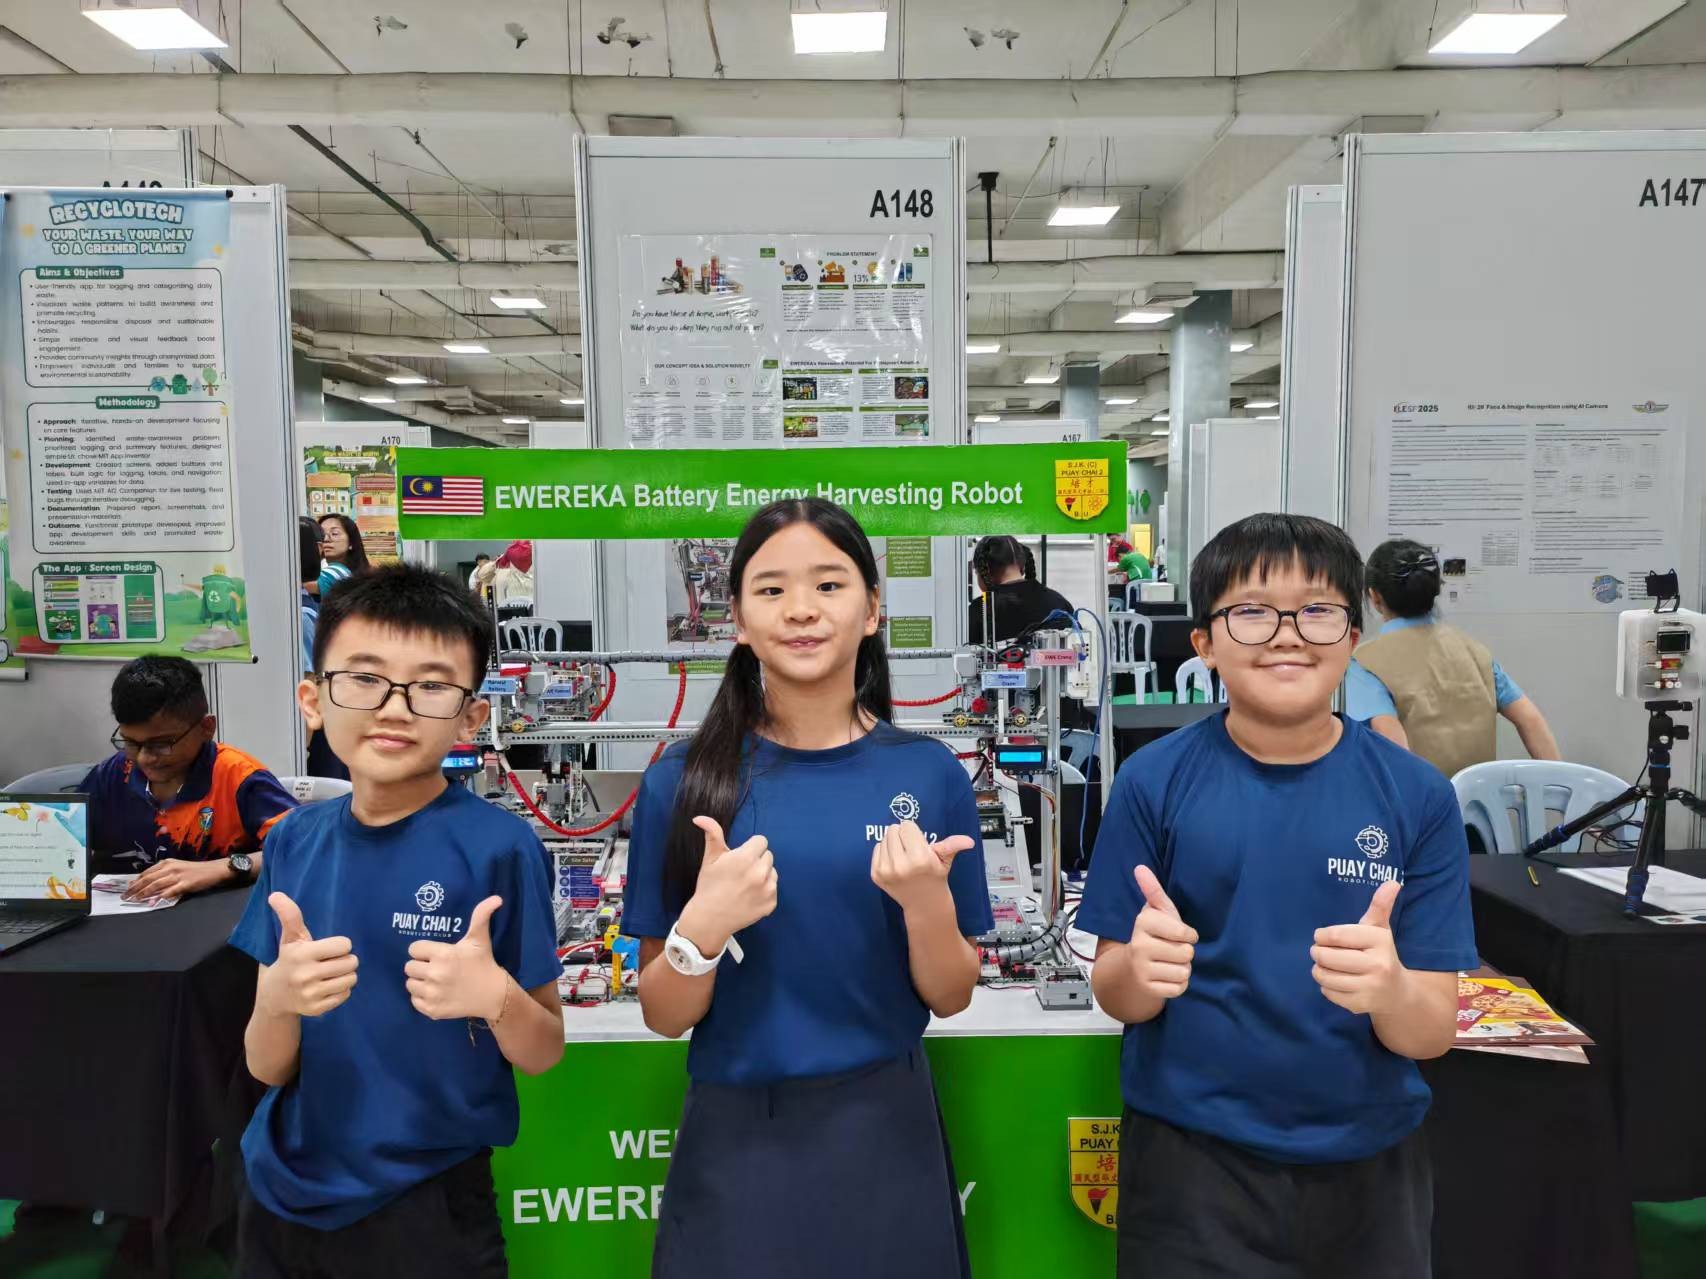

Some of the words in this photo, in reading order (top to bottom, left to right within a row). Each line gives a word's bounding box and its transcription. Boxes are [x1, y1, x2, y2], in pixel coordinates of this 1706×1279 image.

[1639, 178, 1706, 206] A147
[870, 189, 933, 218] A148
[50, 199, 184, 225] RECYCLOTECH
[42, 228, 77, 241] YOUR
[127, 228, 161, 241] YOUR
[163, 228, 194, 241] WAY
[52, 242, 69, 255] TO
[72, 242, 82, 255] A
[85, 242, 137, 255] GREENER
[140, 242, 186, 255] PLANET
[39, 268, 61, 277] Aims
[63, 268, 71, 277] &
[73, 267, 120, 278] Objectives
[854, 274, 869, 283] 13%
[98, 398, 156, 407] Methodology
[1418, 404, 1439, 413] 2025
[381, 436, 400, 445] A170
[495, 484, 626, 509] EWEREKA
[634, 484, 719, 512] Battery
[817, 482, 942, 511] Harvesting
[951, 481, 1023, 505] Robot
[64, 565, 81, 573] App
[89, 564, 121, 572] Screen
[124, 563, 152, 572] Design
[1328, 858, 1366, 877] PUAY
[1369, 862, 1398, 882] CHAI
[392, 912, 420, 930] PUAY
[421, 915, 451, 932] CHAI
[452, 917, 462, 932] 2
[1080, 1139, 1114, 1149] PUAY
